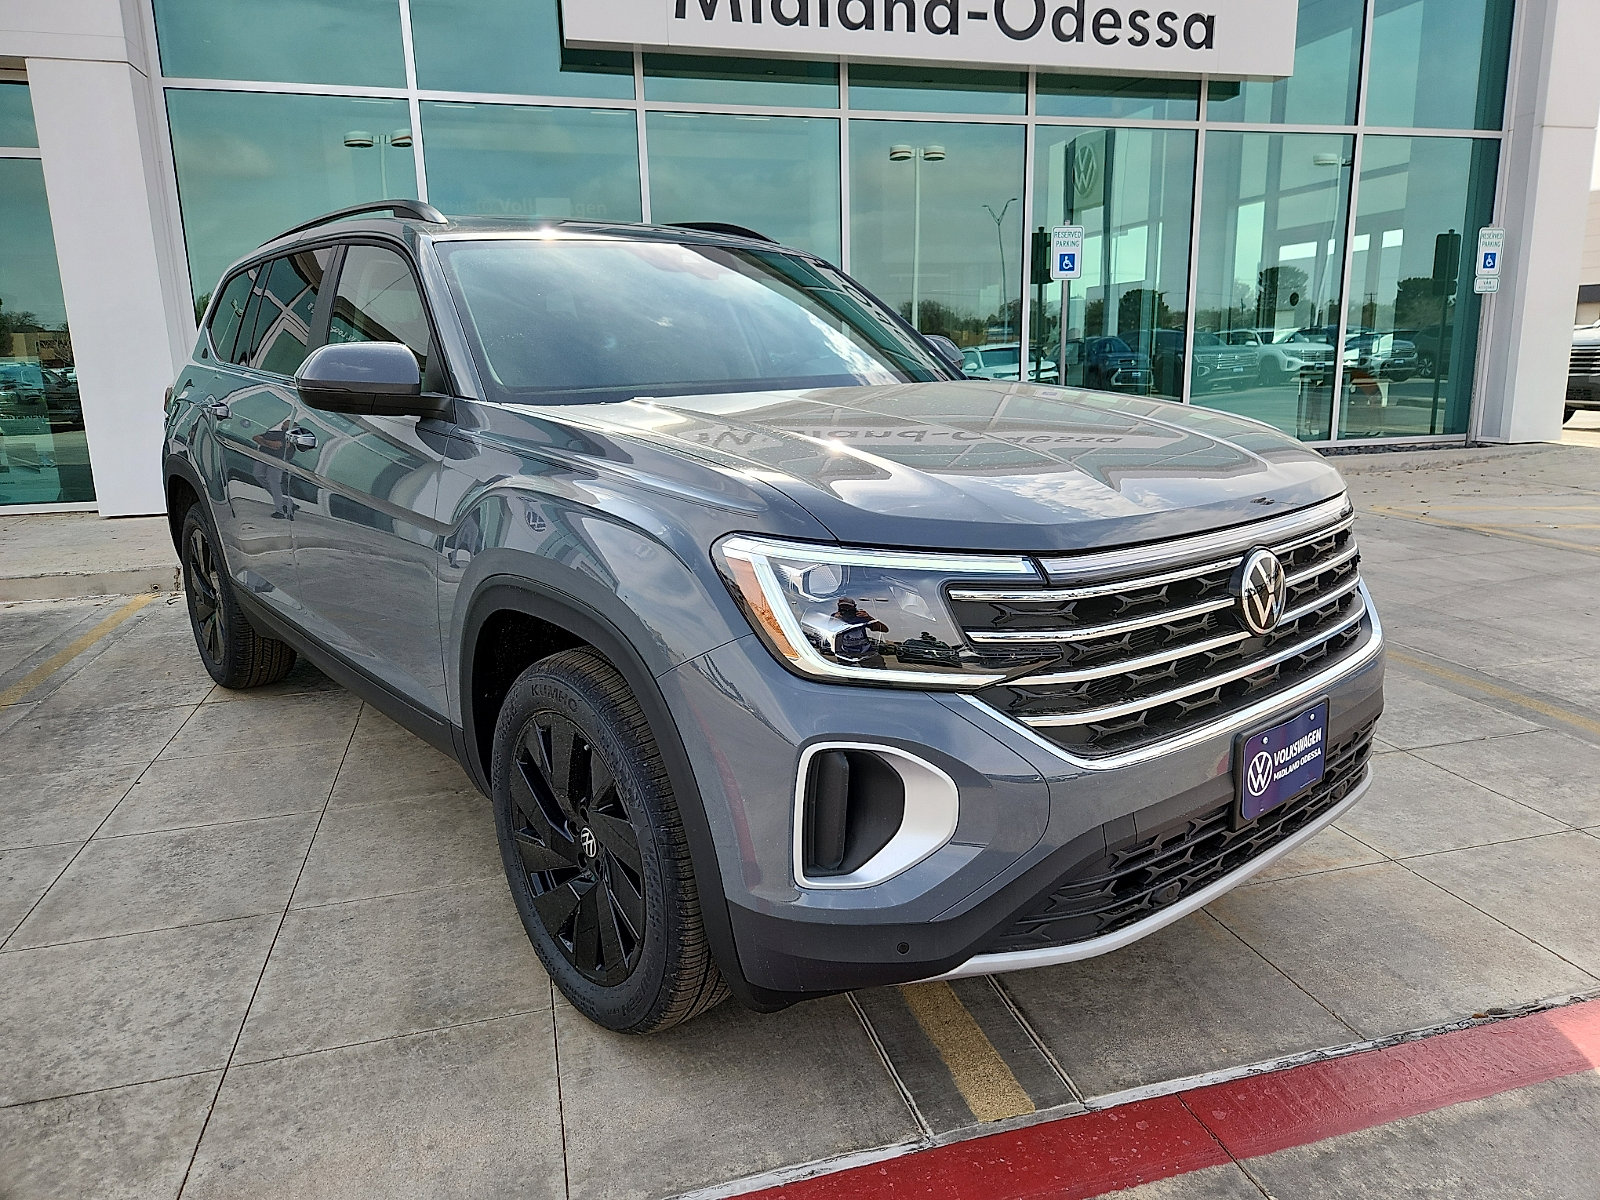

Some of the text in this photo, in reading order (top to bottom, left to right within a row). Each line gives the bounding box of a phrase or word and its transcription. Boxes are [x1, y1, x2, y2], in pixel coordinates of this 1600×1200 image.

[1054, 231, 1082, 239] RESERVED
[1056, 240, 1080, 248] PARKING
[1481, 232, 1504, 240] RESERVED
[531, 684, 578, 713] KUMHO
[1273, 727, 1322, 767] VOLKSWAGEN
[1273, 747, 1322, 782] MIDLAND ODESSA
